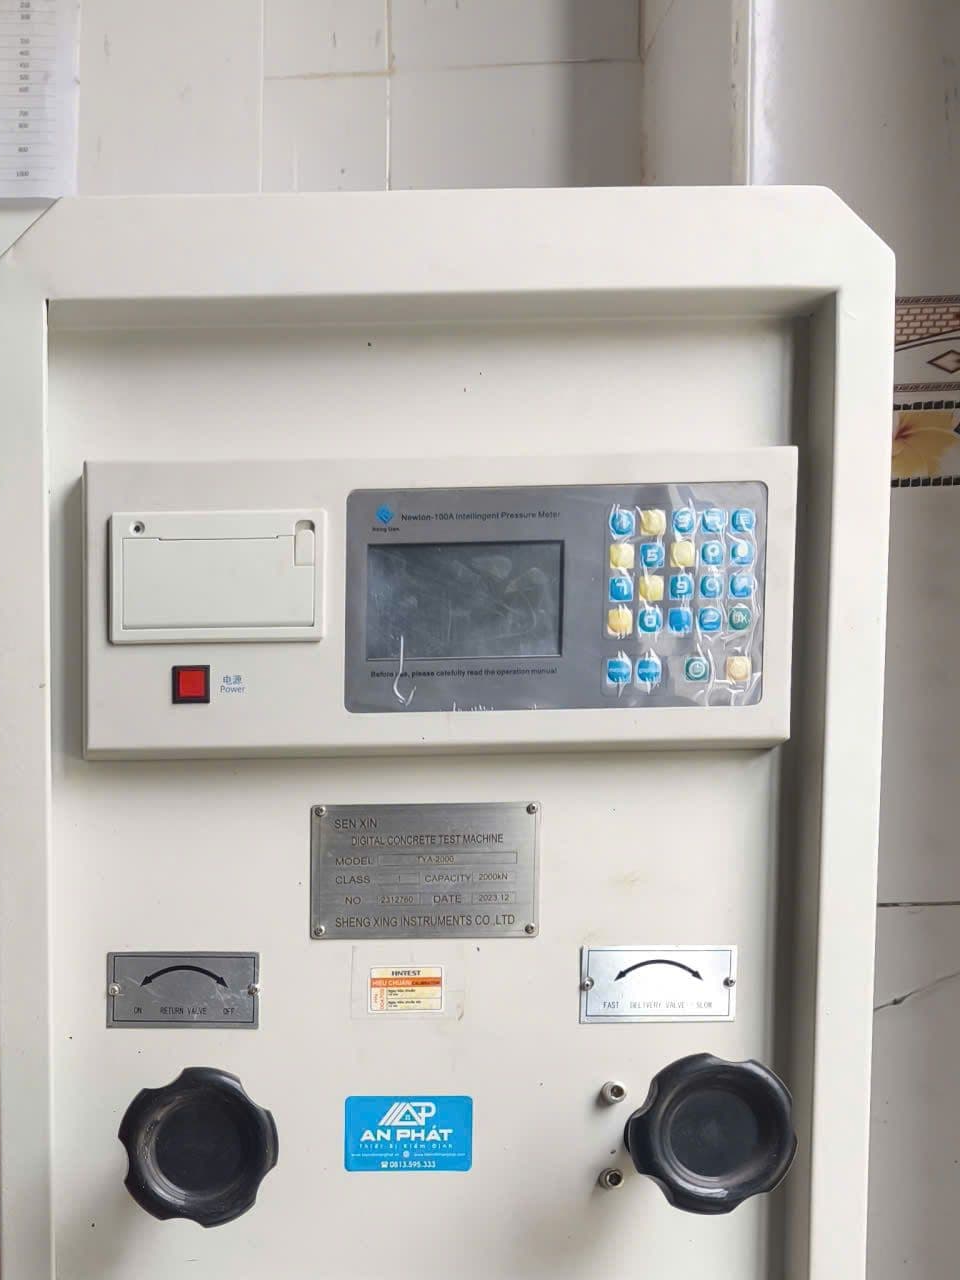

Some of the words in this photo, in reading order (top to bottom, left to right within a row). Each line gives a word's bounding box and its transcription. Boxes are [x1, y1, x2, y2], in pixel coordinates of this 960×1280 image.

[501, 510, 536, 519] Pressure
[412, 670, 434, 679] please
[496, 668, 530, 677] operation
[220, 685, 245, 693] Power
[334, 819, 356, 829] SEN
[359, 818, 377, 828] XIN
[351, 835, 385, 846] DIGITAL
[387, 835, 436, 845] CONCRETE
[438, 834, 461, 845] TEST
[462, 833, 504, 844] MACHINE
[335, 856, 373, 866] MODEL
[416, 855, 455, 864] TYA-2000
[335, 875, 371, 885] CLASS
[424, 874, 471, 883] CAPACITY
[478, 872, 508, 881] 2000kN
[344, 896, 361, 905] NO
[433, 895, 462, 904] DATE
[335, 917, 371, 928] SHENG
[373, 917, 397, 927] XING
[400, 915, 472, 927] INSTRUMENTS
[602, 1001, 620, 1009] FAST
[629, 1001, 661, 1009] DELIVERY
[665, 1001, 685, 1009] VALVE
[160, 1007, 184, 1015] RETURN
[186, 1007, 207, 1015] VALVE
[223, 1007, 235, 1015] OFF
[360, 1129, 391, 1142] AN
[396, 1124, 453, 1142] PHÁT
